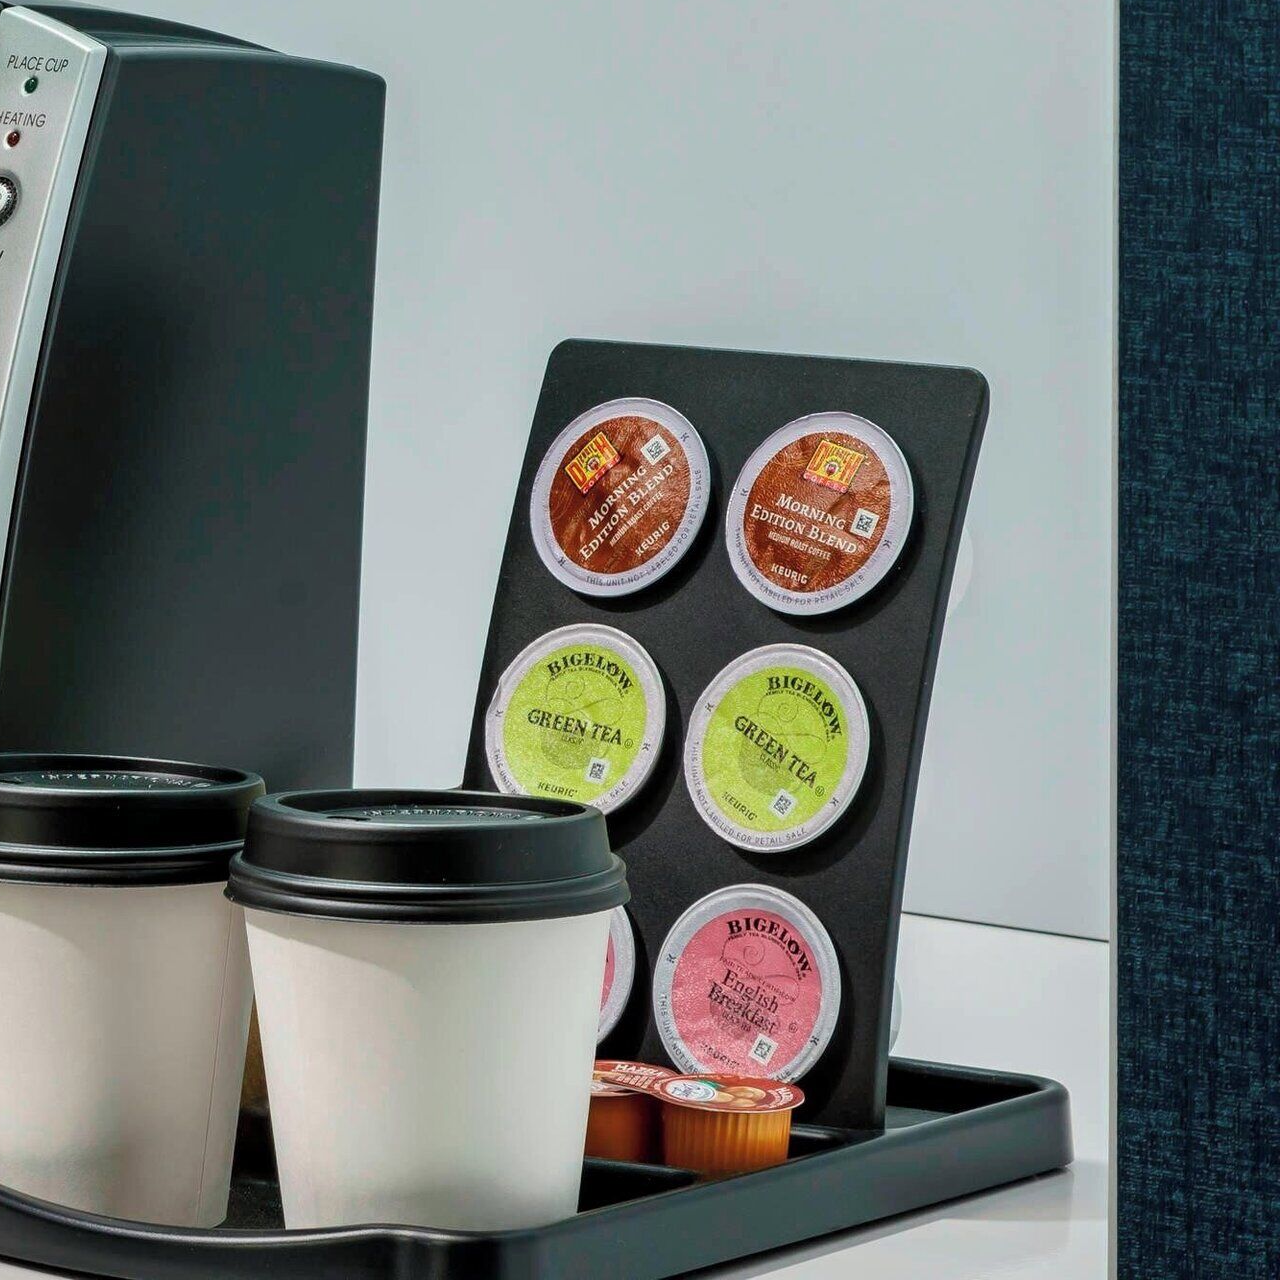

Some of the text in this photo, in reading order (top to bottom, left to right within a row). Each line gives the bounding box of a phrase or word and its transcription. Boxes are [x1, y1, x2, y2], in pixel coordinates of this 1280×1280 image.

[7, 54, 69, 73] PLACE CUP
[579, 464, 674, 560] EDITION BLEND
[589, 467, 647, 530] MORNING
[775, 493, 846, 530] MORNING
[635, 521, 671, 557] KEURIG
[750, 504, 857, 554] EDITION BLEND
[809, 546, 832, 561] COFFEE
[771, 563, 809, 585] KEURIG
[547, 652, 634, 690] BIGELOW
[767, 675, 842, 736] BIGELOW
[527, 708, 588, 738] GREEN
[591, 724, 622, 746] TEA
[734, 716, 789, 763] GREEN
[788, 755, 817, 789] TEA
[538, 782, 575, 798] KEURIG
[722, 791, 756, 821] KEURIG
[736, 832, 752, 843] FOR
[726, 917, 812, 972] BIGELOW
[708, 982, 776, 1036] Breakfast
[721, 969, 779, 1013] English
